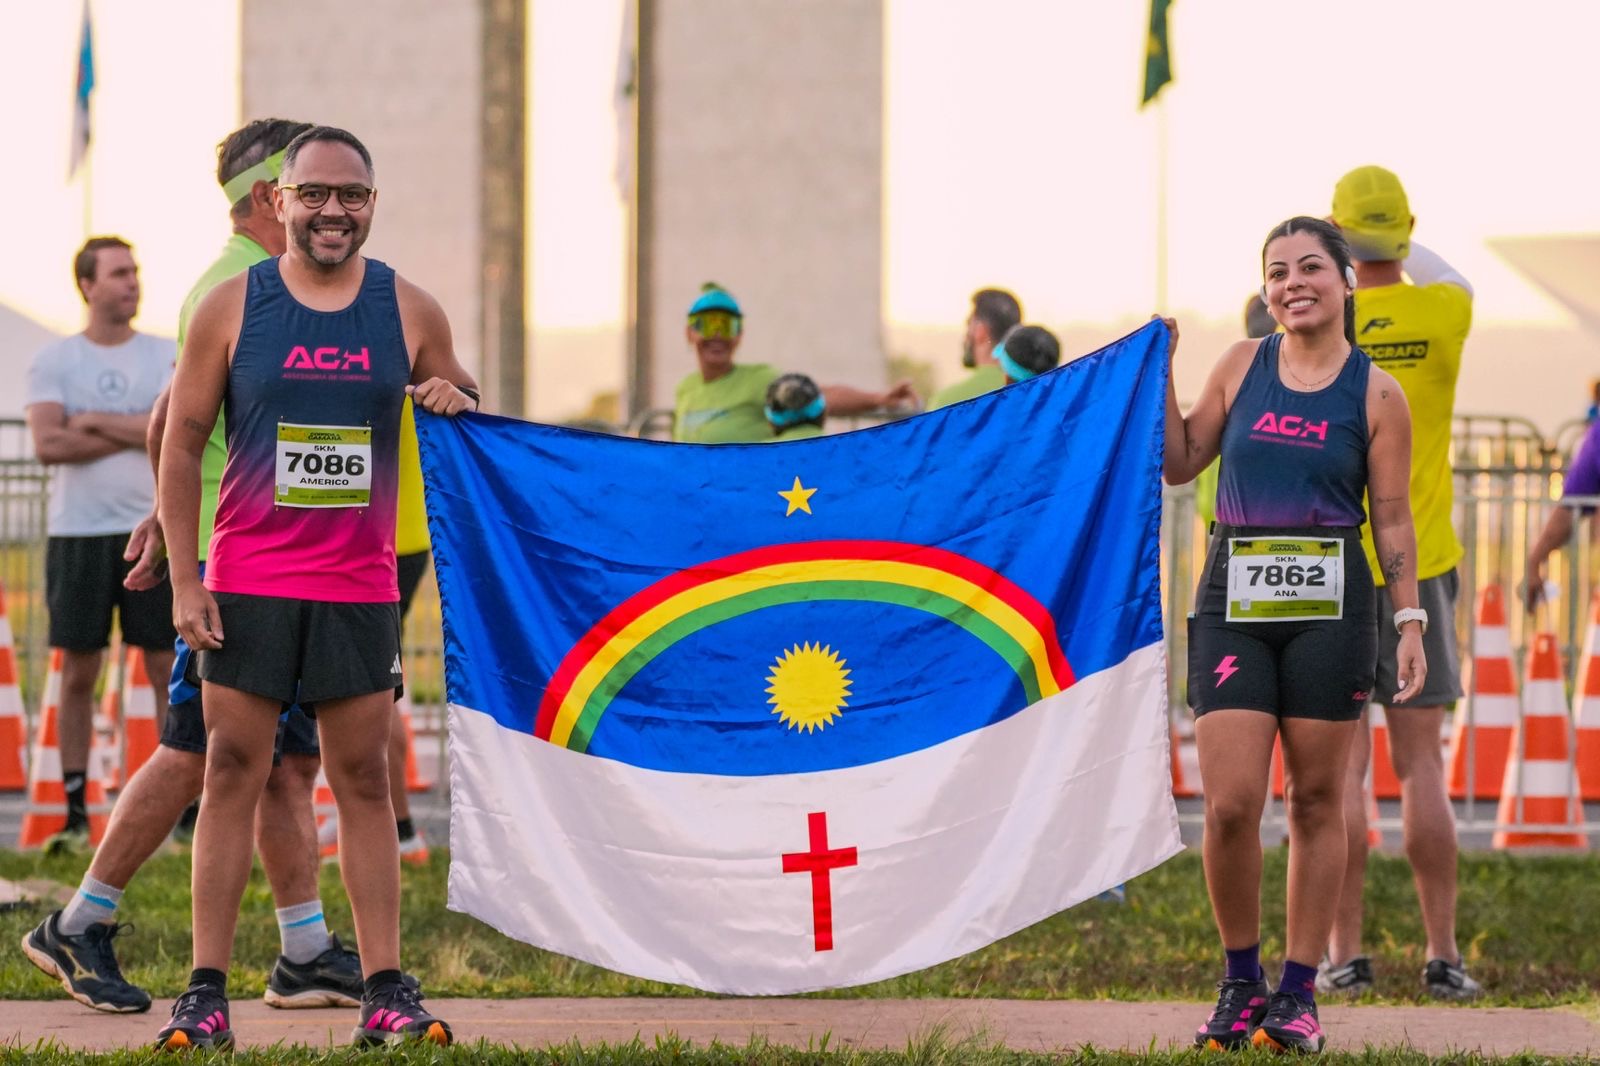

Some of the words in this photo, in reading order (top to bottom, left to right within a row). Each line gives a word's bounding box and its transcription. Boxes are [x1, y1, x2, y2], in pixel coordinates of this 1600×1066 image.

[283, 345, 370, 370] ACH
[1252, 412, 1328, 440] ACH
[285, 452, 365, 476] 7086
[300, 477, 349, 486] AMERICO
[1247, 565, 1325, 587] 7862
